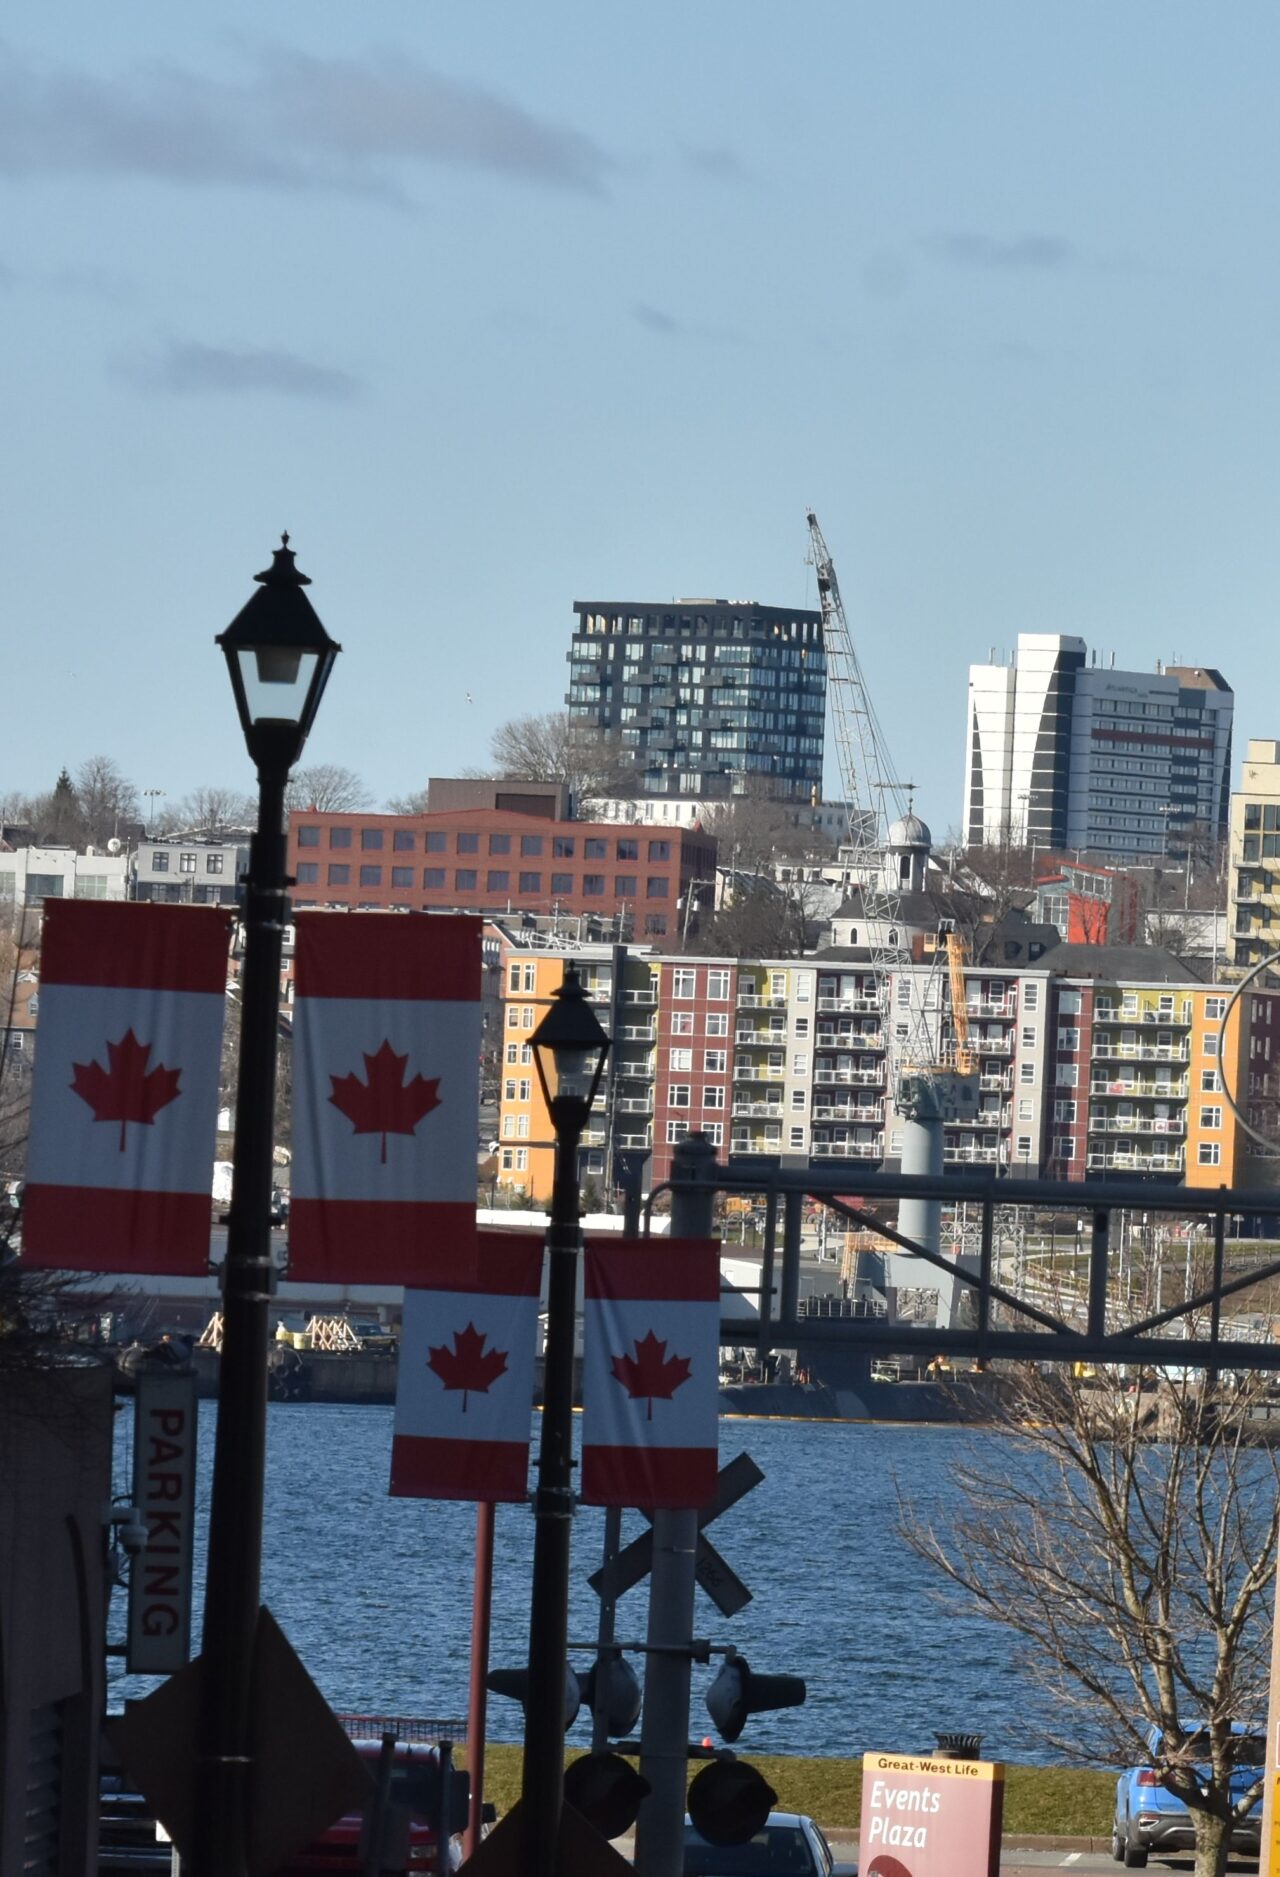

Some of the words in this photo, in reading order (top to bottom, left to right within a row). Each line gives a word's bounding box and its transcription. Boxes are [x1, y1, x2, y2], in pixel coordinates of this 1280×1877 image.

[142, 1408, 184, 1637] PARKING
[878, 1758, 952, 1774] Great-West
[955, 1765, 979, 1776] Life
[870, 1780, 941, 1813] Events
[868, 1816, 927, 1849] Plaza
